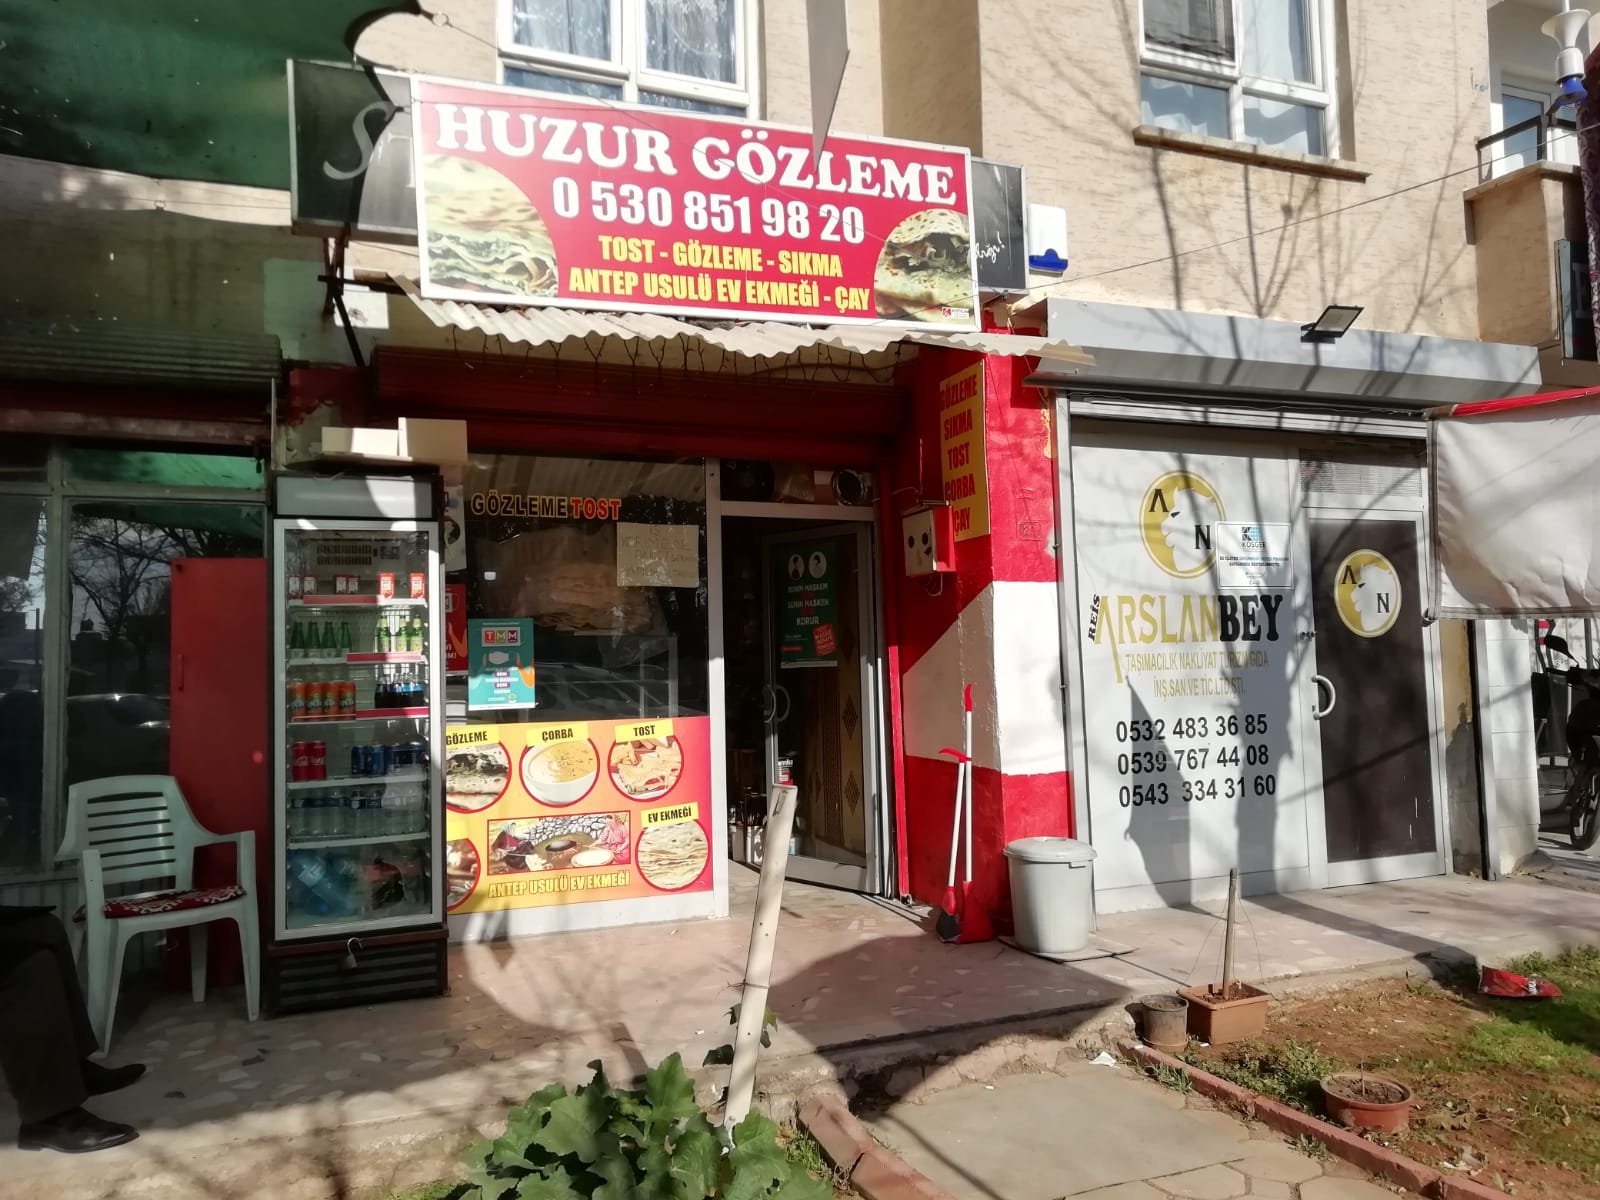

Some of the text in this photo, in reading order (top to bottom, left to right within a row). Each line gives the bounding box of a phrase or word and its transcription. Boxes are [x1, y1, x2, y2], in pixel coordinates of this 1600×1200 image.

[434, 103, 957, 205] HUZUR GÖZLEME
[553, 176, 865, 244] 0 530 851 98 20
[598, 235, 655, 263] TOST
[672, 239, 763, 272] GÖZLEME
[778, 250, 843, 278] SIKMA
[569, 267, 639, 296] ANTEP
[643, 273, 712, 302] USULÜ
[716, 278, 741, 303] EV
[746, 279, 820, 308] EKMEĞİ
[835, 286, 870, 313] ÇAY
[944, 408, 973, 440] SIKMA
[947, 441, 970, 471] TOST
[471, 489, 622, 520] GÖZLEME TOST
[1194, 524, 1211, 549] N
[1376, 592, 1390, 613] N
[796, 616, 819, 625] KORUR
[1125, 651, 1177, 676] TAŞIMACILIK
[1179, 648, 1217, 670] NAKLİYAT
[1249, 650, 1269, 668] GIDA
[445, 731, 488, 746] GÖZLEME
[542, 728, 574, 743] ÇORBA
[633, 725, 655, 737] TOST
[1116, 714, 1268, 743] 0532 483 36 85
[1117, 744, 1269, 775] 0539 767 44 08
[1119, 774, 1276, 808] 0543 334 31 60
[648, 805, 692, 823] EV EKMEĞİ
[488, 870, 630, 898] ANTEP USULÜ EV EKMEĞİ
